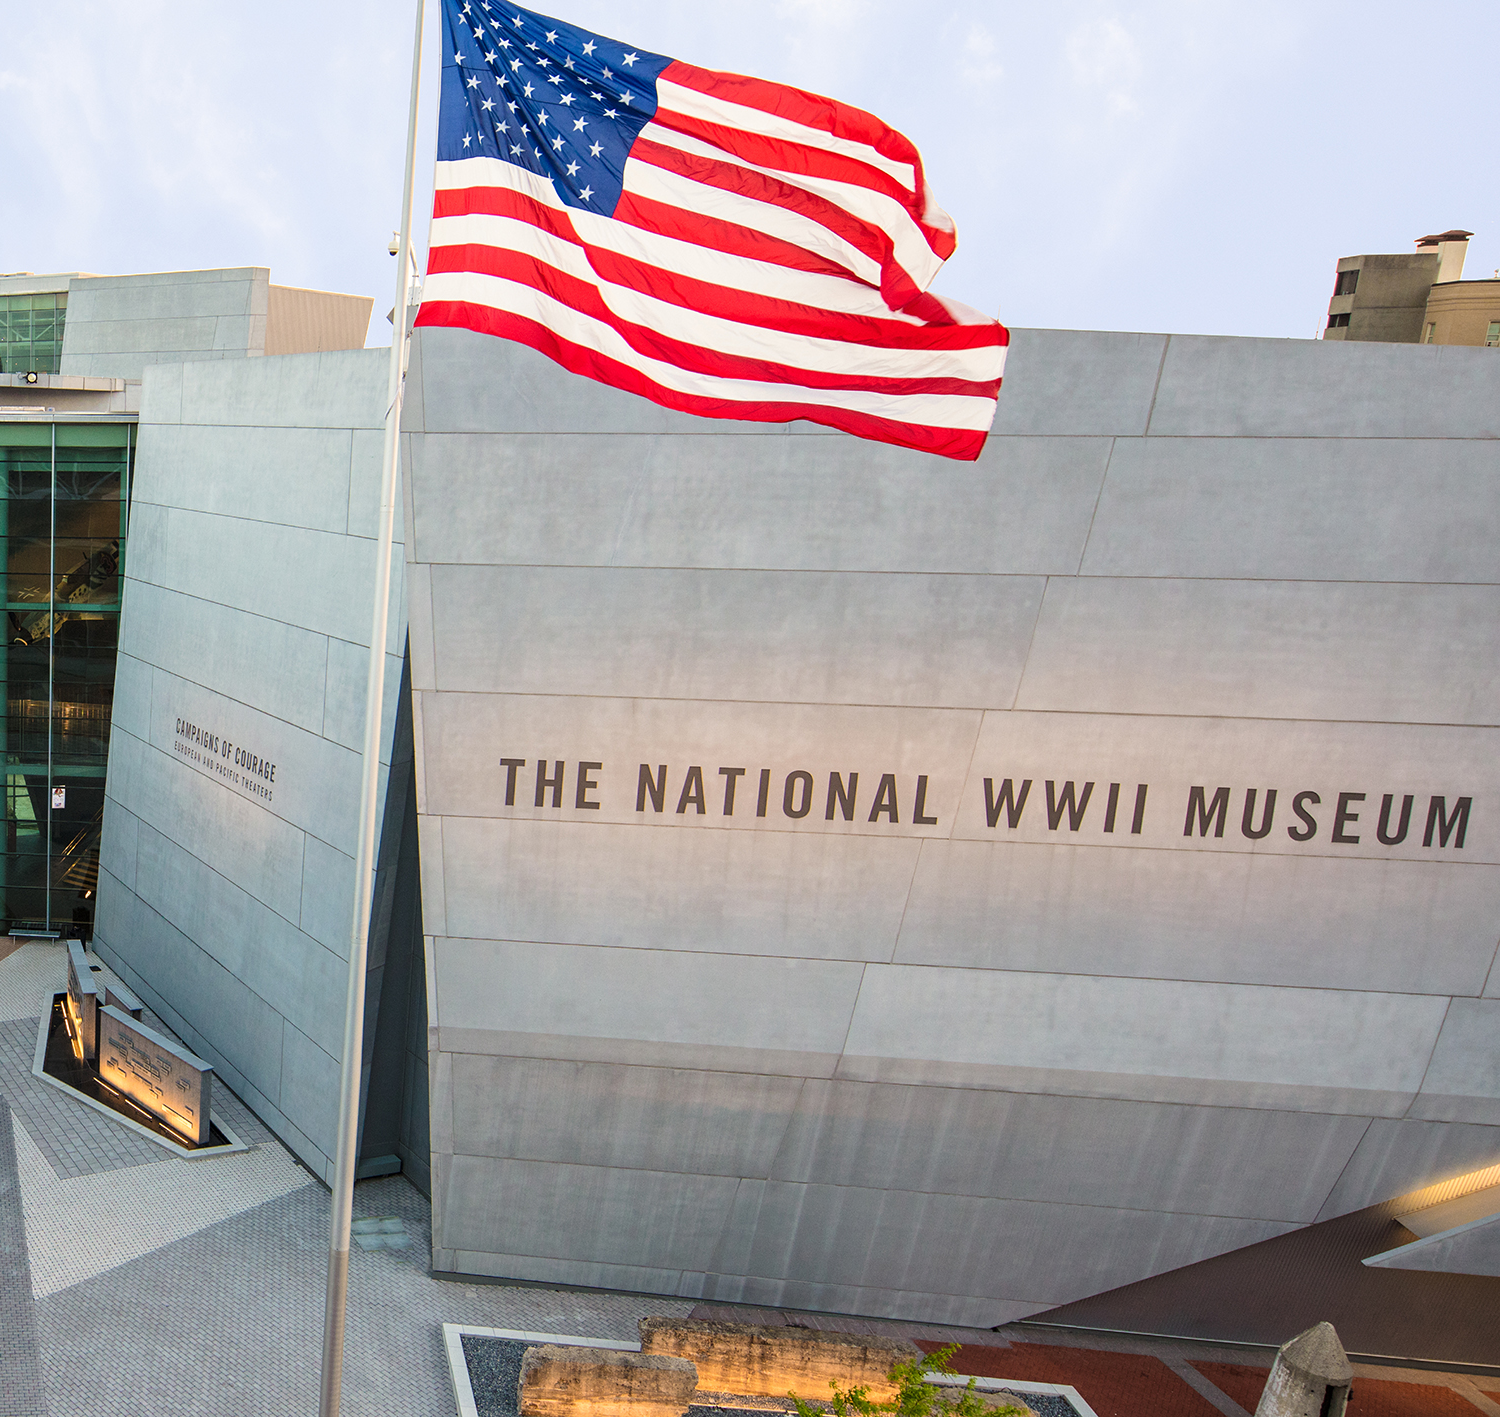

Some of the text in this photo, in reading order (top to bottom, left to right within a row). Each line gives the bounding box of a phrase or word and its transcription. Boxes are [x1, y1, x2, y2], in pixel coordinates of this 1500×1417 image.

[174, 740, 273, 801] EUROPEAN AND PACIFIC THEATERS
[176, 718, 276, 783] CAMPAIGNS OF COURAGE
[499, 757, 1474, 849] THE NATIONAL WWII MUSEUM
